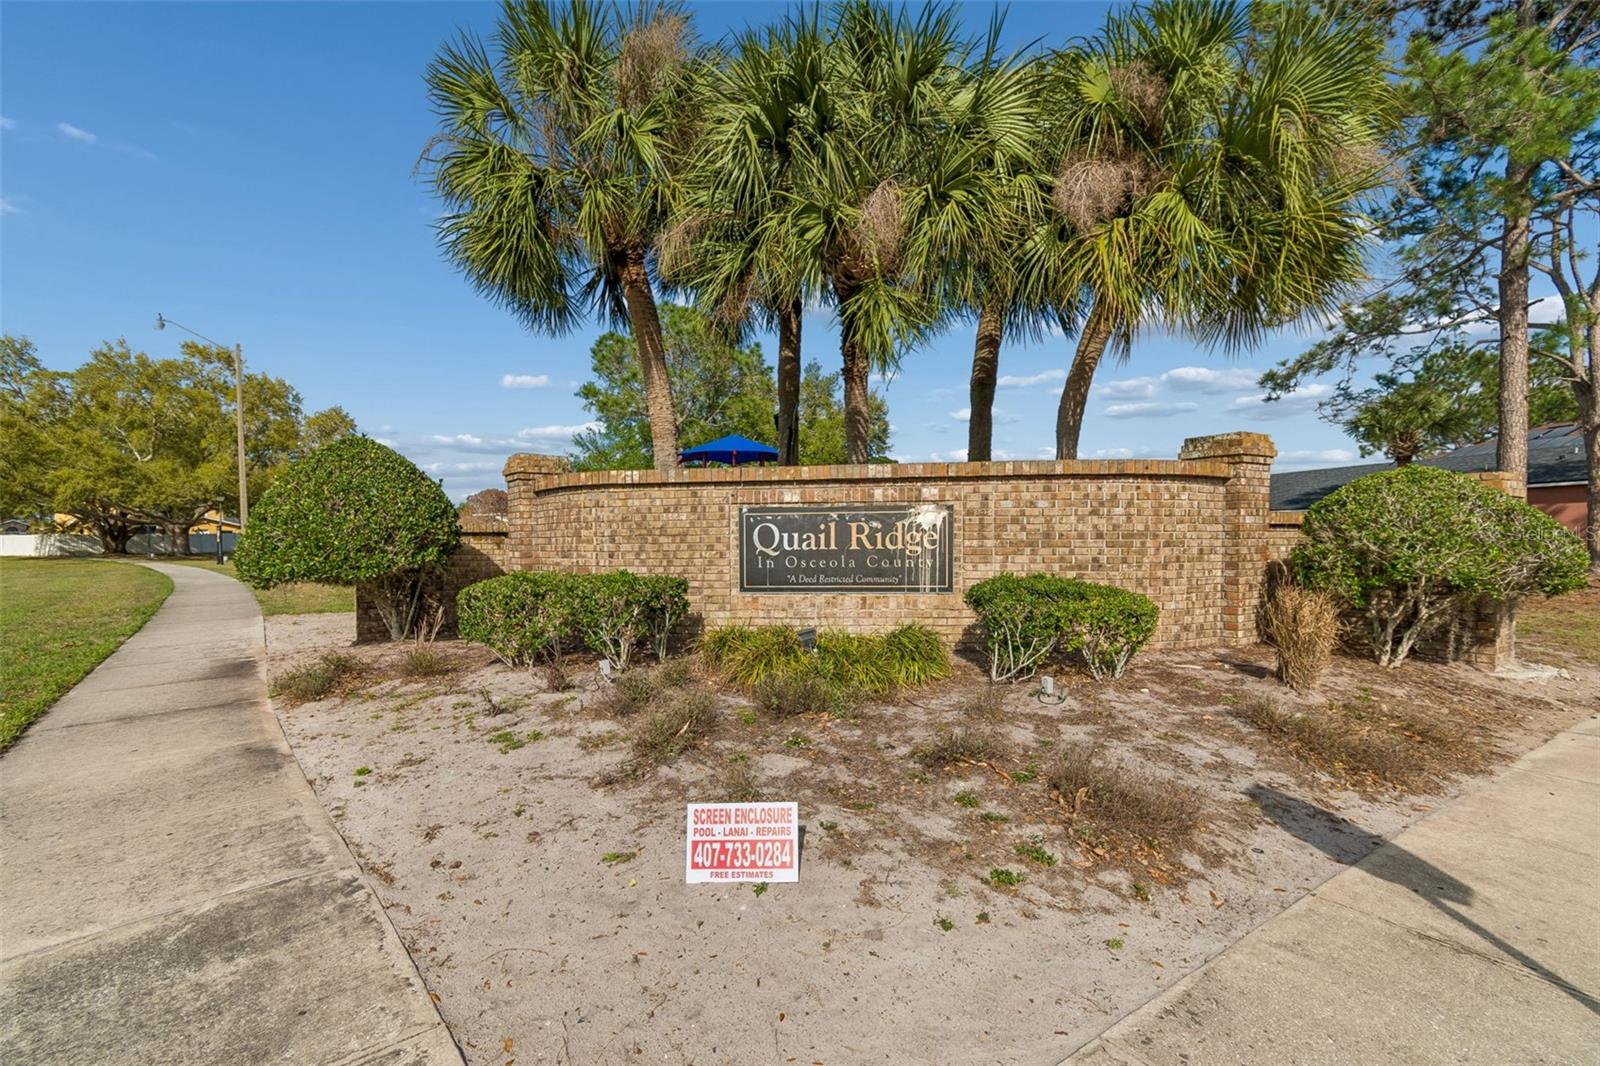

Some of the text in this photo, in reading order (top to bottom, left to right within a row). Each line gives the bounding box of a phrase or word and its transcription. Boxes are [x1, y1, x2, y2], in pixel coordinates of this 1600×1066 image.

[753, 521, 938, 557] Quail Ridge
[757, 555, 934, 569] In Osceola County
[798, 574, 818, 583] Deed
[819, 574, 854, 583] Restricted
[693, 807, 793, 825] SCREEN ENCLOSURE
[693, 827, 716, 837] POOL
[723, 827, 749, 837] LANAI
[755, 826, 791, 836] REPAIRS
[693, 841, 792, 868] 407-733-0284
[710, 871, 774, 879] FREE ESTIMATES
